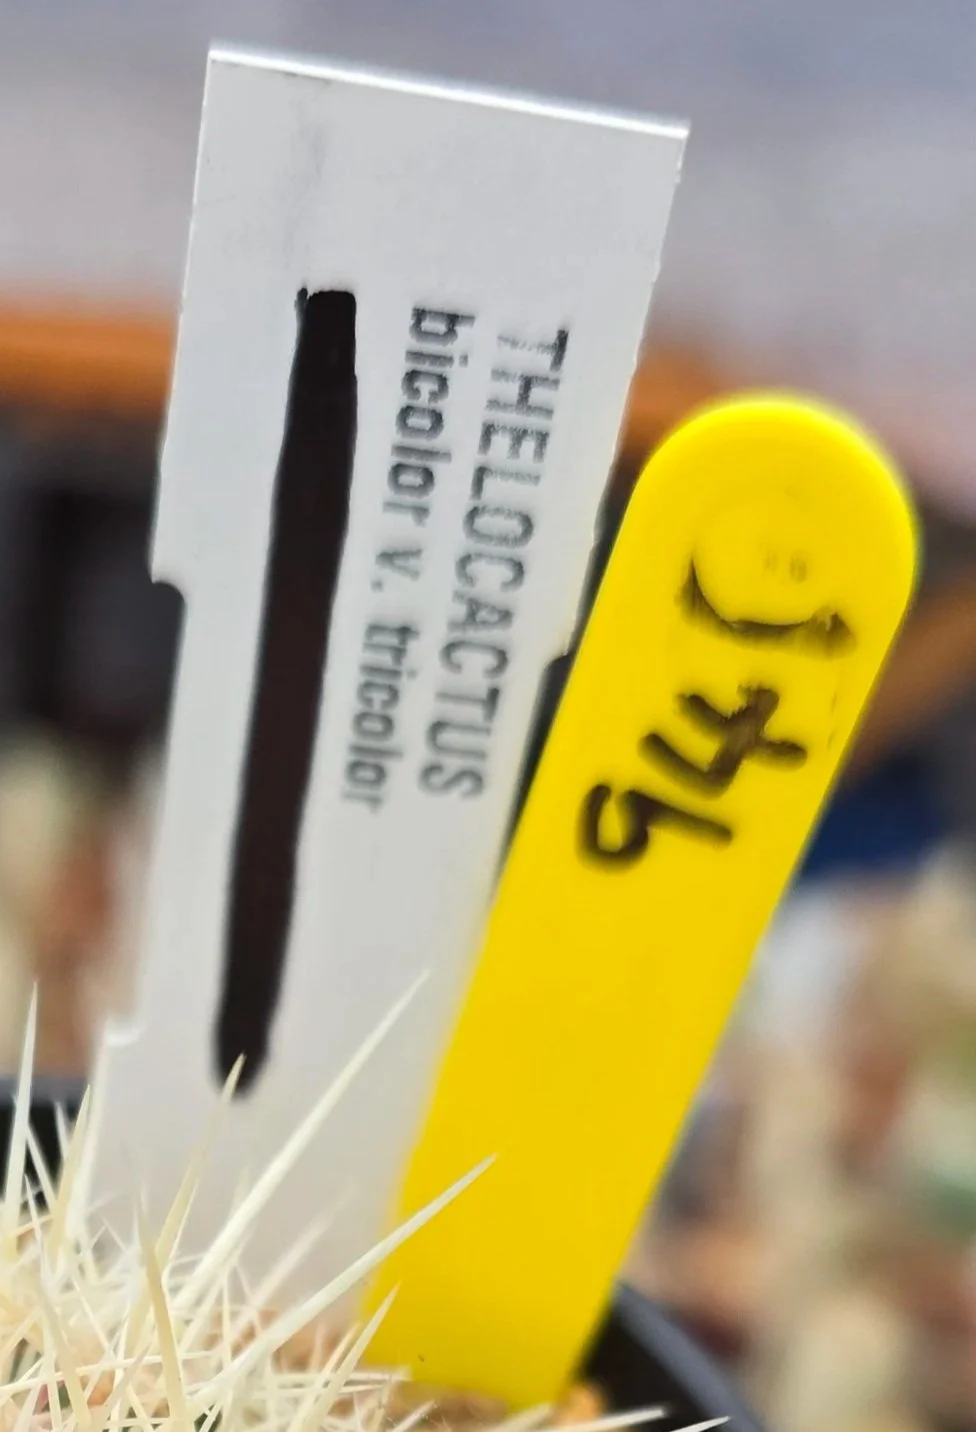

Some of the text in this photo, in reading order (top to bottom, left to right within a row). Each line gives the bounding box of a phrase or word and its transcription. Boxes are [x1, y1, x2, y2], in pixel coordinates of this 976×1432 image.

[341, 305, 477, 814] bicolor v. tricolor
[417, 327, 571, 802] THELOCACTUS
